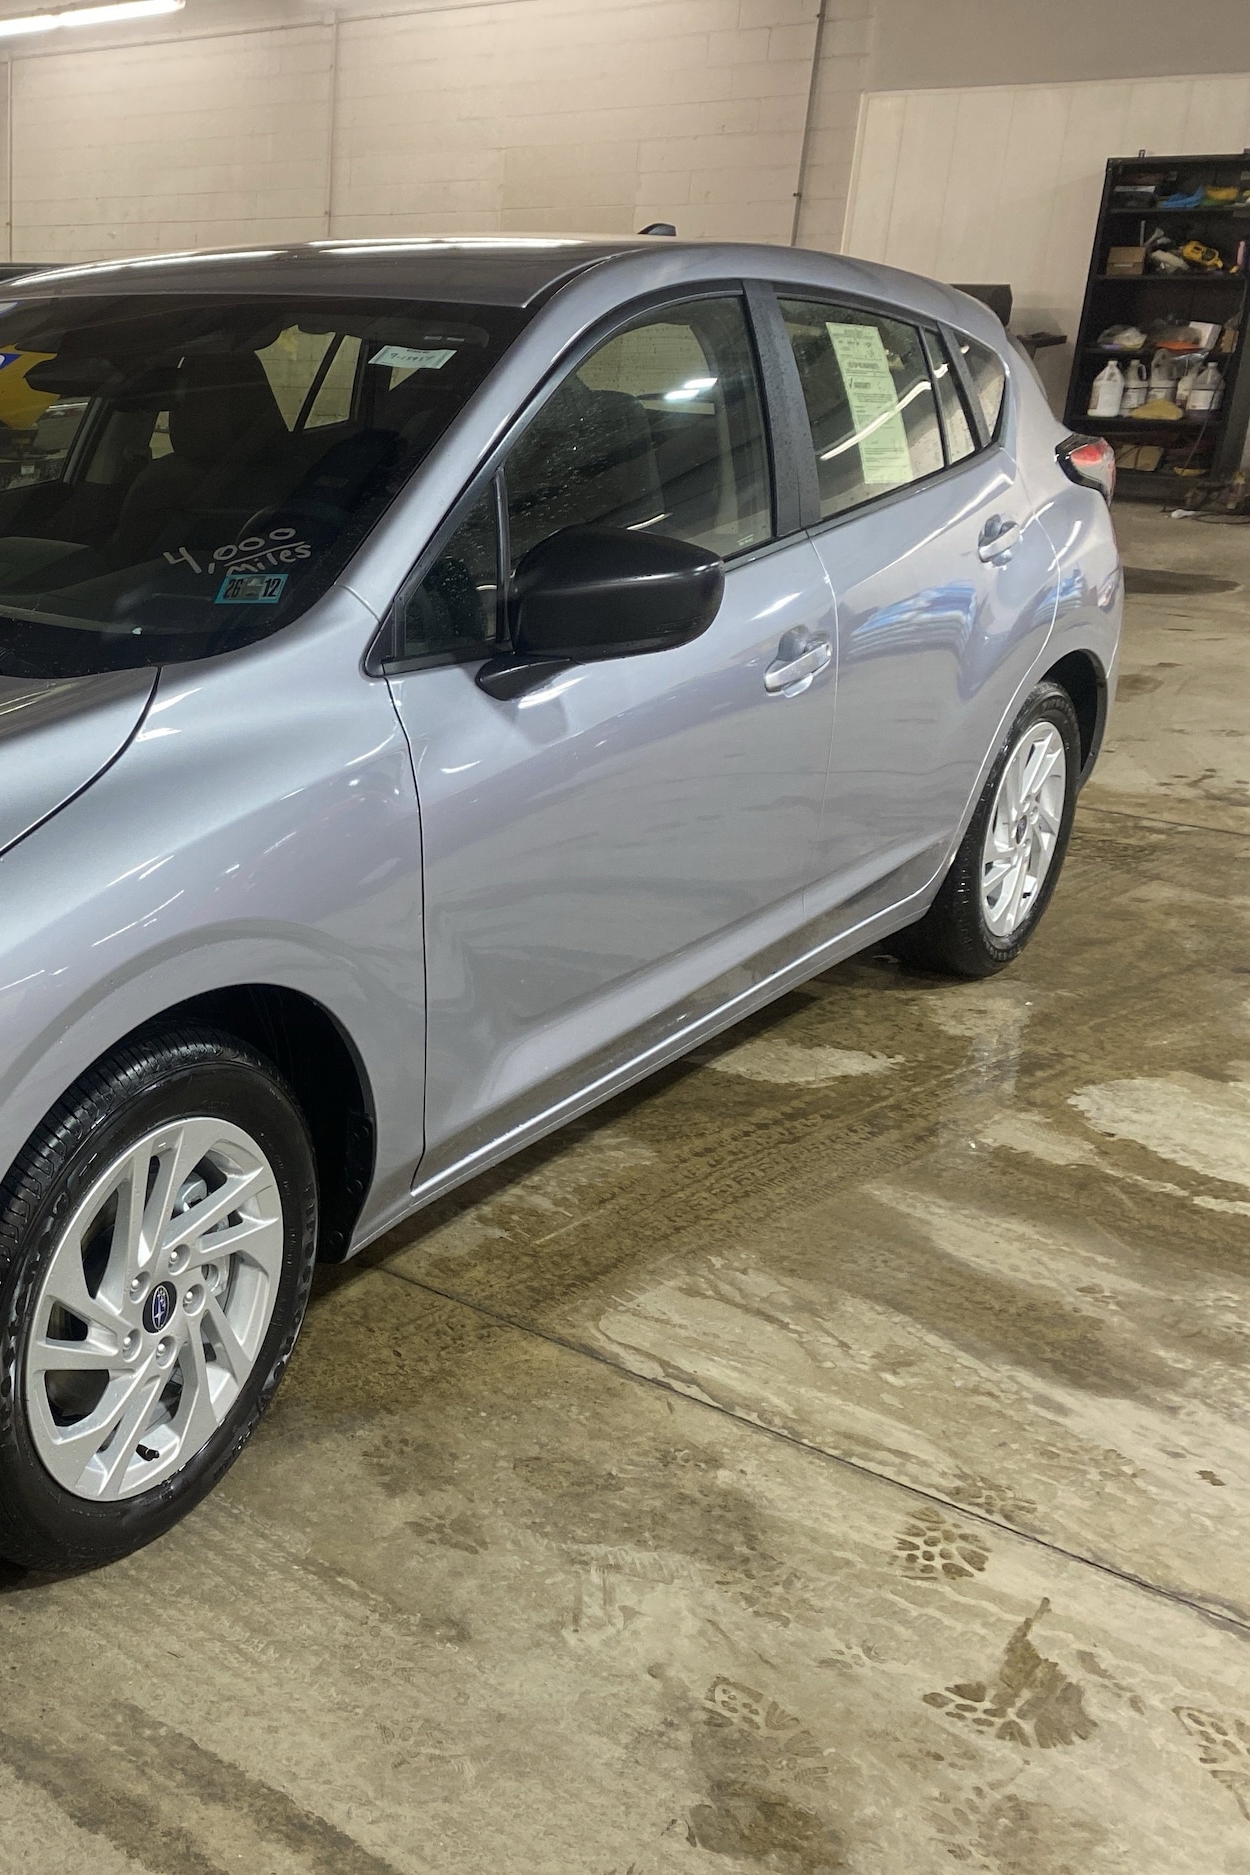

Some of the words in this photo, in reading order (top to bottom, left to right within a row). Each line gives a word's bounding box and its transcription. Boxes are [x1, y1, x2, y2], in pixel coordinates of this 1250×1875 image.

[163, 527, 297, 575] 4,000
[223, 578, 244, 599] 26
[261, 577, 282, 598] 12
